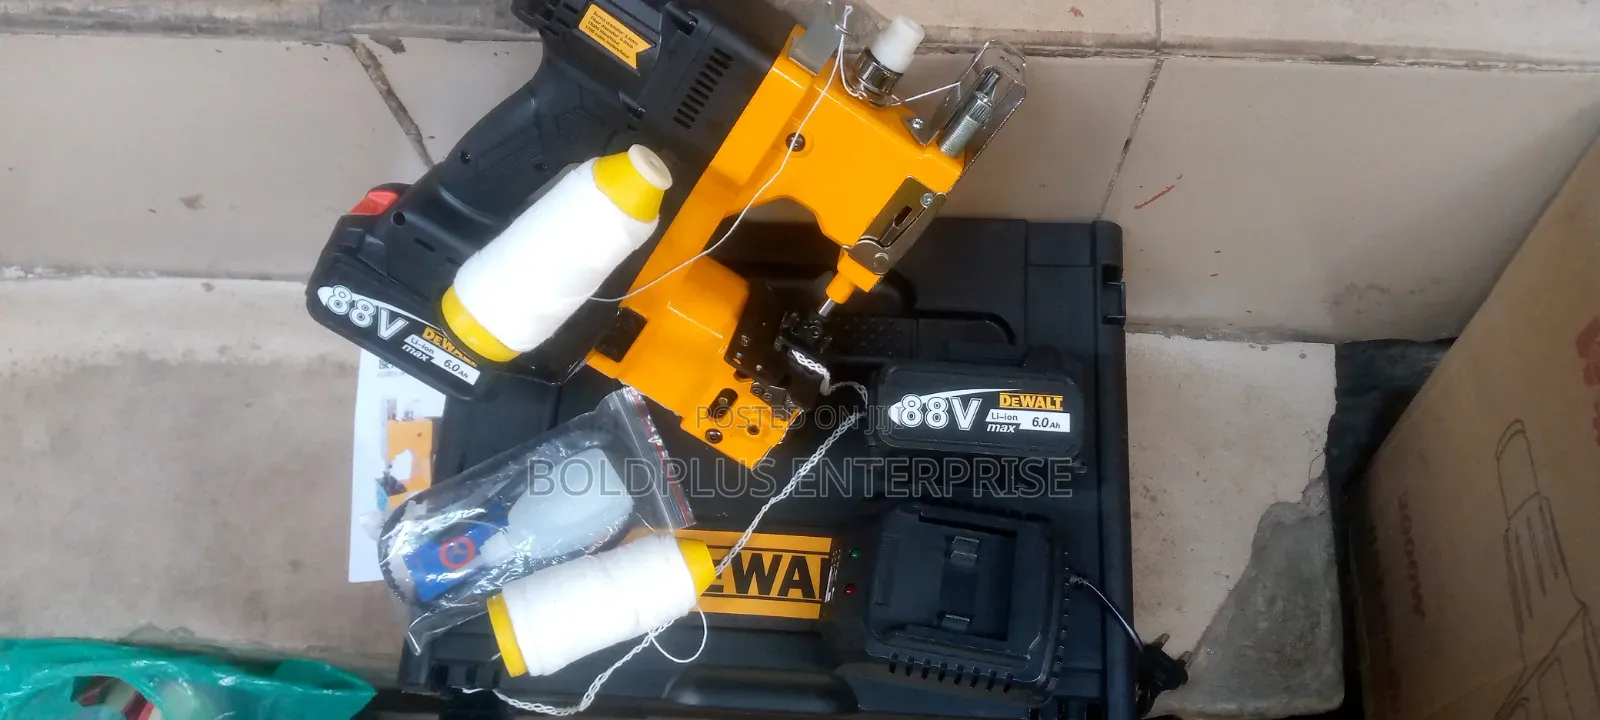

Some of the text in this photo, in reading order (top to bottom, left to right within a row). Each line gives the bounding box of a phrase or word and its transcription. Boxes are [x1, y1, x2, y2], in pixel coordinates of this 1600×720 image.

[327, 285, 409, 341] 88V
[401, 344, 430, 362] max
[900, 393, 983, 431] 88V
[986, 423, 1017, 433] max
